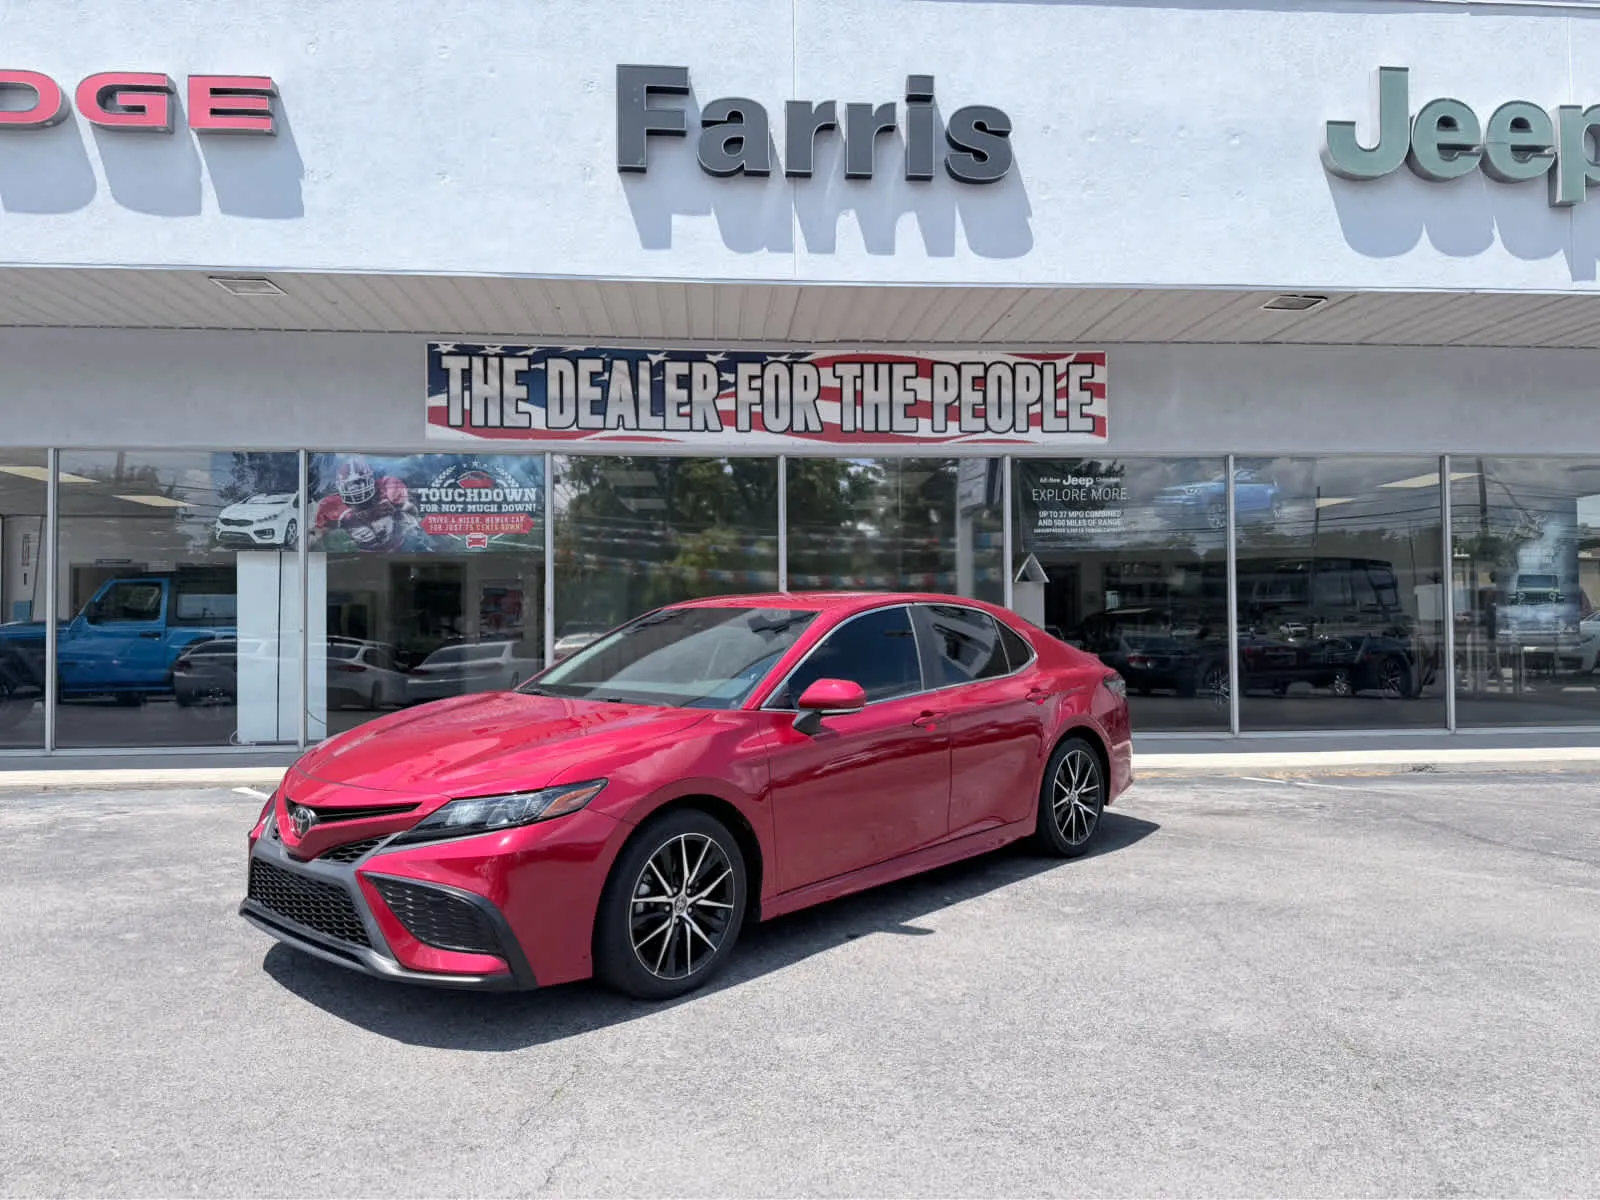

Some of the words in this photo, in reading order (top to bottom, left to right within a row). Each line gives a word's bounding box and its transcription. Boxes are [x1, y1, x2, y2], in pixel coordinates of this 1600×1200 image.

[615, 63, 1014, 184] Farris
[1321, 66, 1600, 207] Jeep
[440, 354, 532, 429] THE
[544, 356, 724, 433] DEALER
[734, 359, 824, 434] FOR
[832, 361, 919, 434] THE
[930, 360, 1096, 434] PEOPLE
[1062, 474, 1094, 487] Jeep
[418, 487, 537, 502] TOUCHDOWN
[1032, 487, 1088, 501] EXPLORE
[420, 503, 436, 512] FOR
[441, 503, 463, 512] NOT
[467, 503, 498, 512] MUCH
[501, 503, 537, 512] DOWN!
